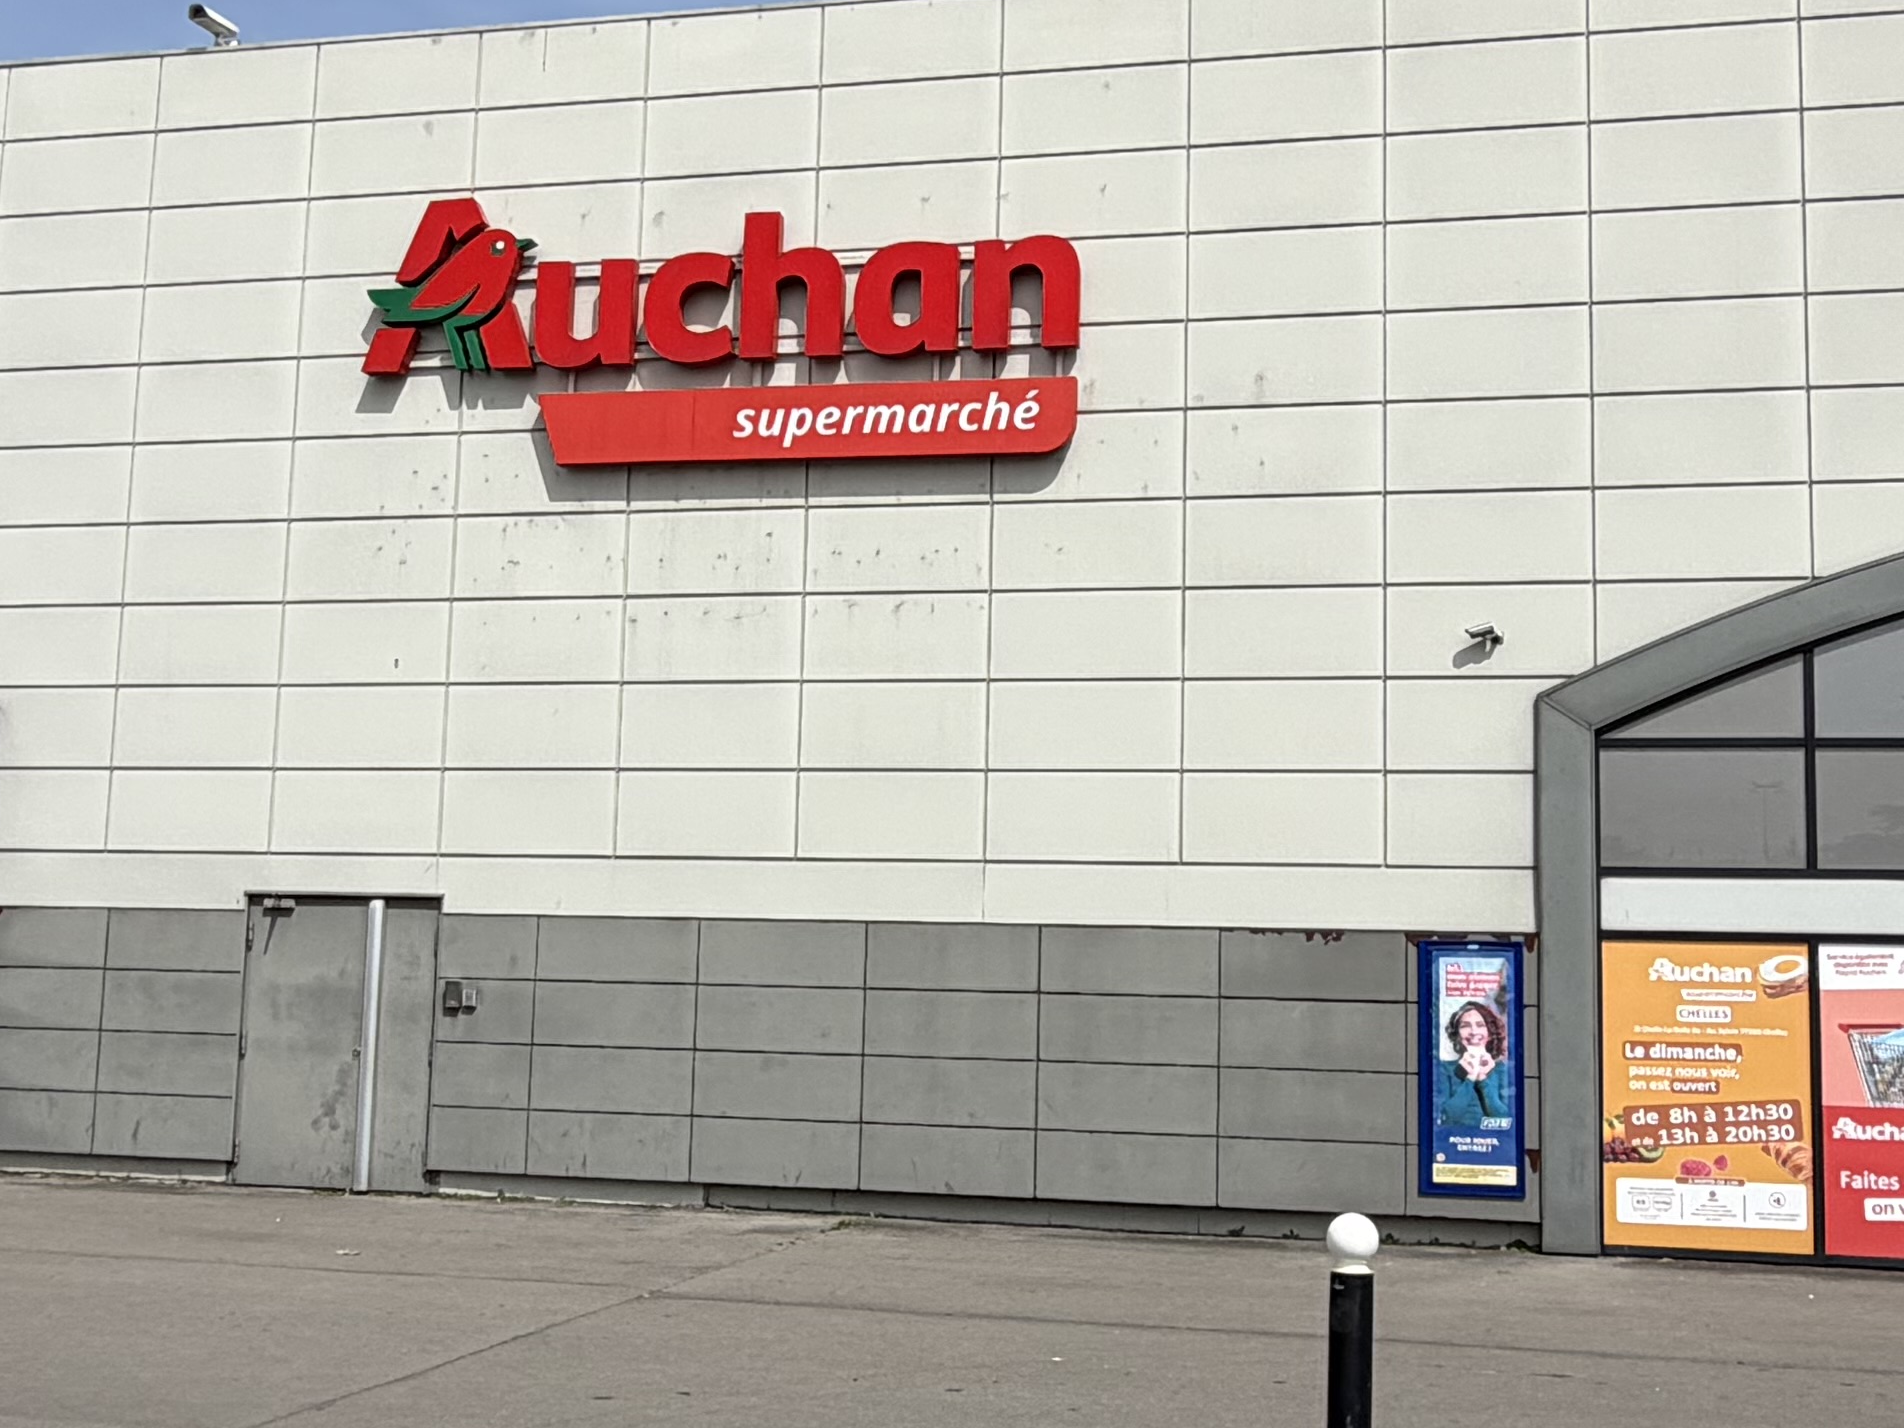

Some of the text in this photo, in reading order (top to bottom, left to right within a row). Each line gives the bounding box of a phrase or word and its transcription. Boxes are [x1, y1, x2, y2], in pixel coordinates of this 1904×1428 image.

[361, 197, 1080, 375] Auchan
[732, 389, 1040, 448] supermarché
[1648, 957, 1753, 983] Auchan
[1678, 1008, 1729, 1020] CHELLES
[1625, 1042, 1743, 1063] Le dimanche,
[1629, 1066, 1740, 1079] passez nous voir,
[1629, 1080, 1717, 1092] on est ouvert
[1631, 1103, 1794, 1125] de 8h à 12h30
[1658, 1127, 1700, 1146] 13h
[1706, 1126, 1719, 1144] à
[1725, 1124, 1795, 1143] 20h30
[1840, 1170, 1900, 1191] Faites
[1871, 1204, 1894, 1215] on
